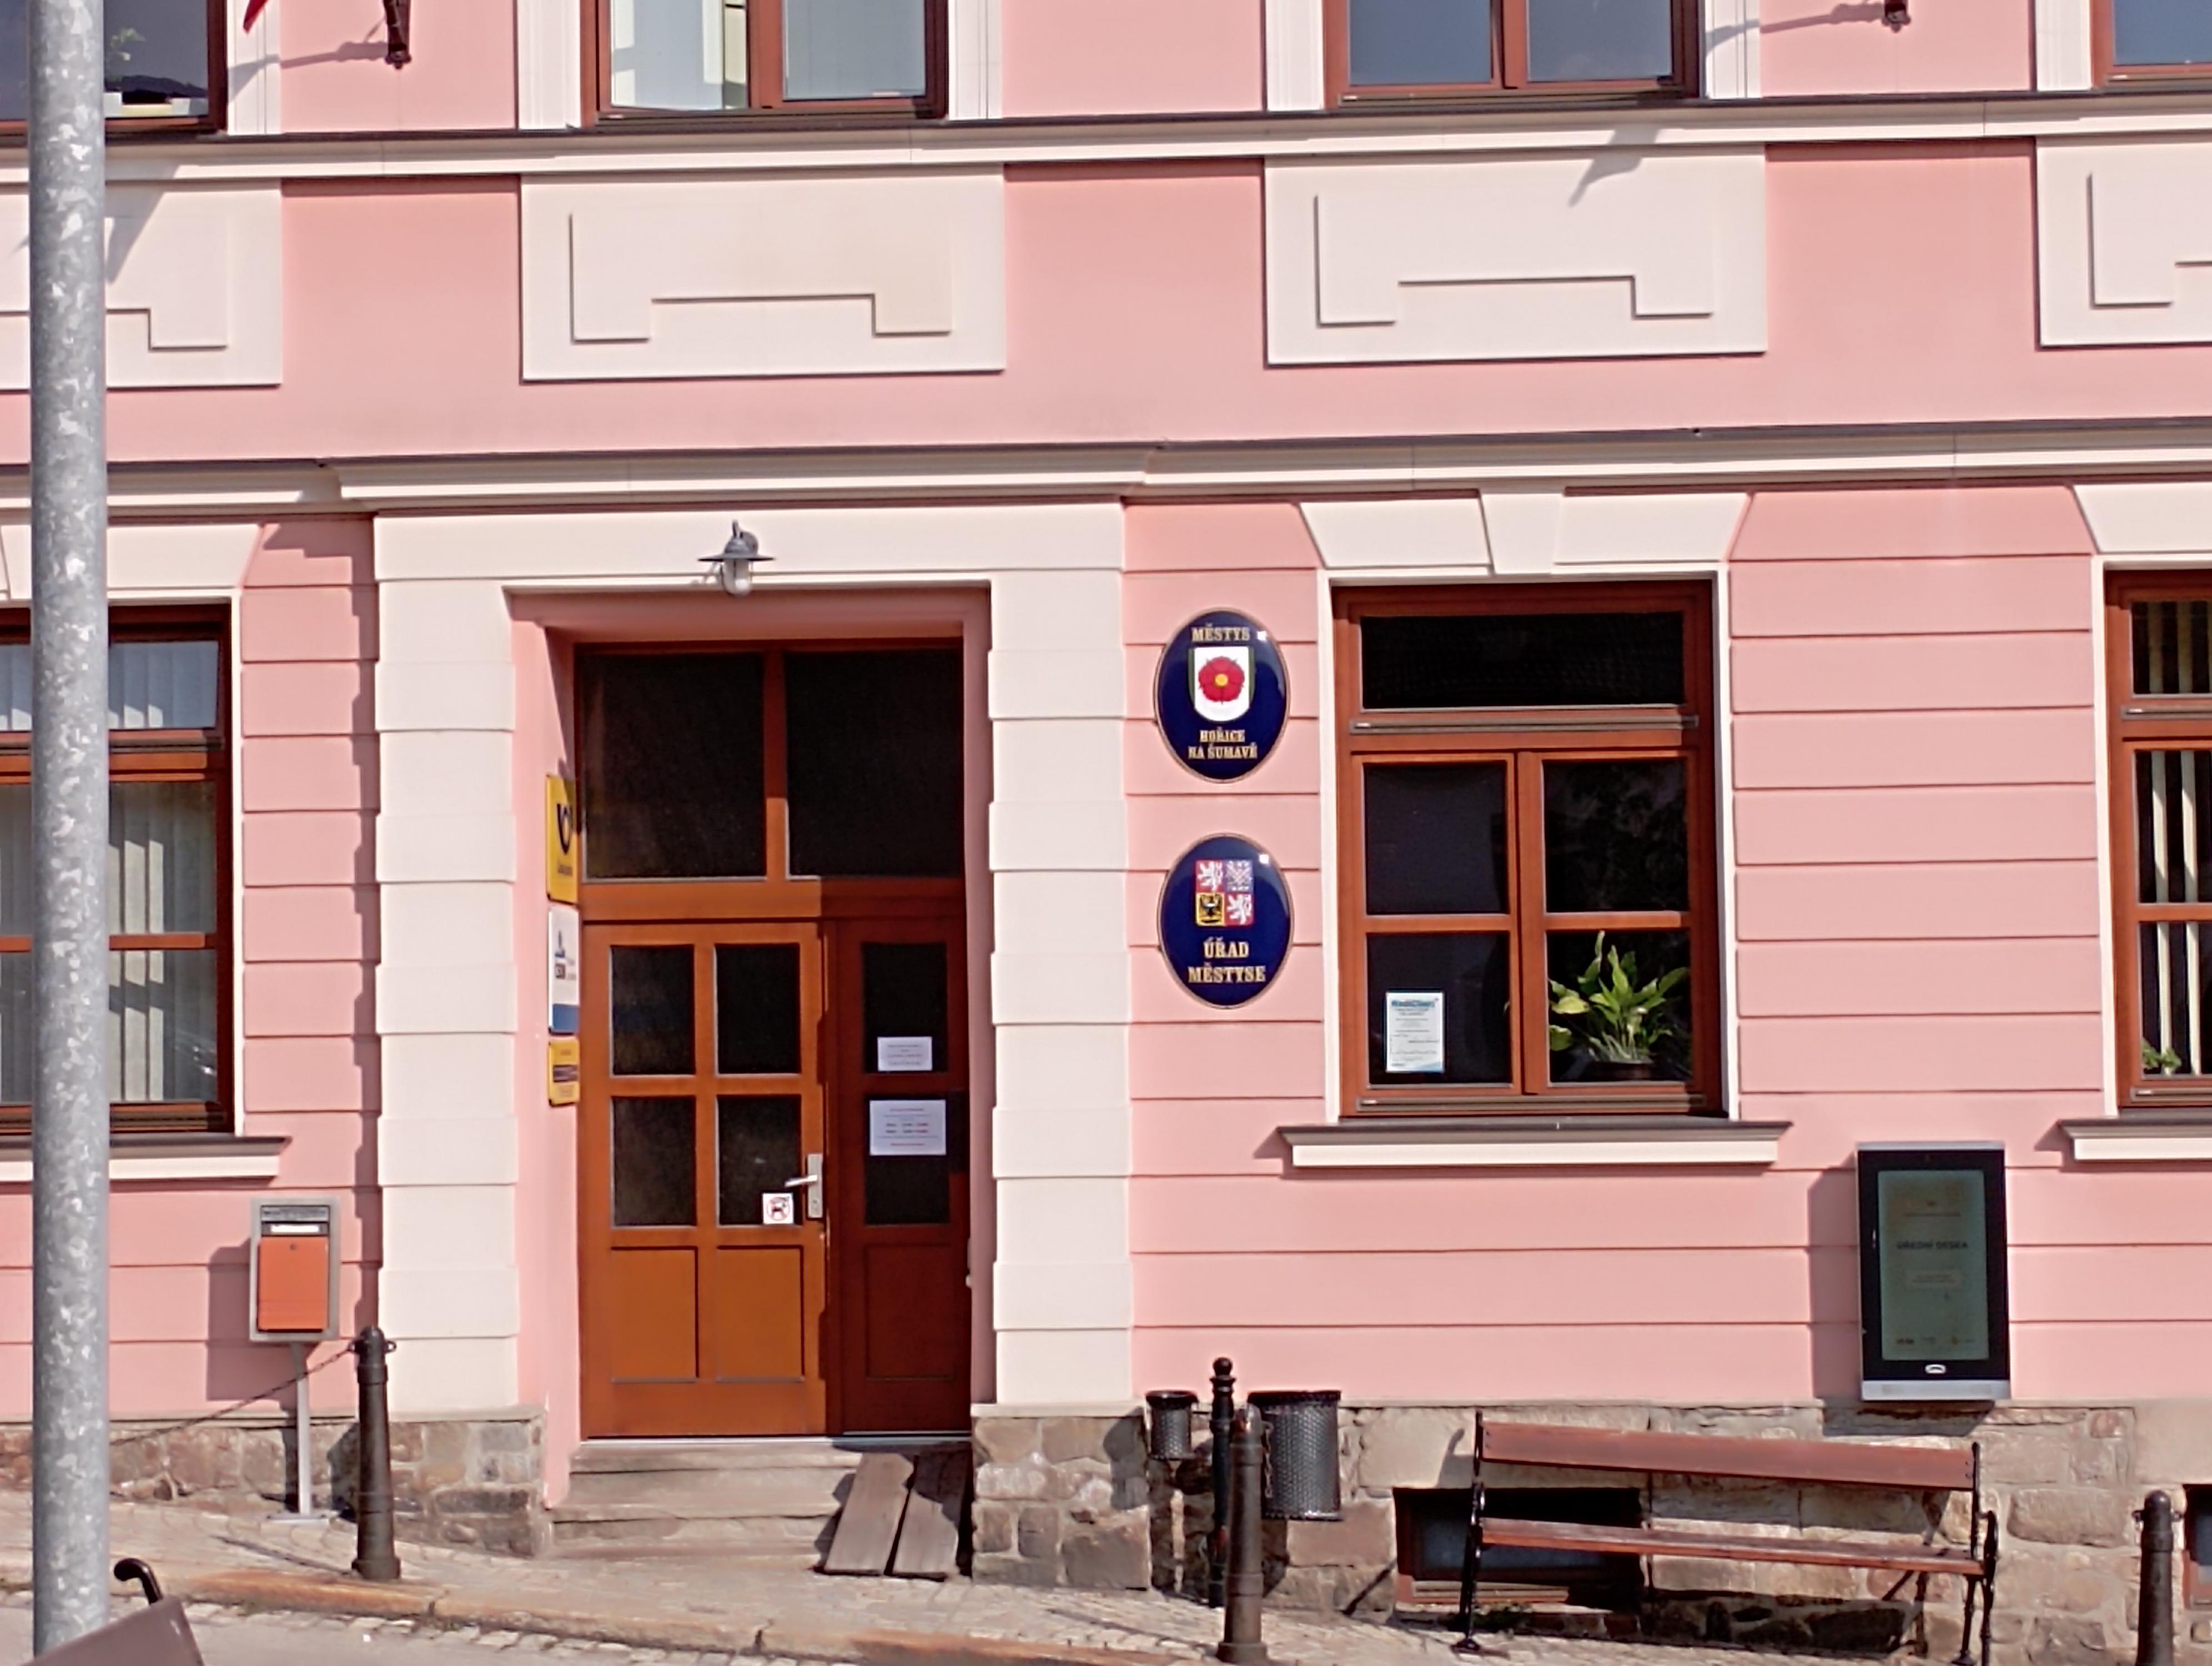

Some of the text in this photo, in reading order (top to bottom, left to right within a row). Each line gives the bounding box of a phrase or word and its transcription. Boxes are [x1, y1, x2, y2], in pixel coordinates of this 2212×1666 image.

[1192, 623, 1250, 641] MĚSTYS
[1200, 726, 1245, 742] HOŘICE
[1188, 742, 1258, 759] NA ŠUMAVĚ
[1204, 937, 1249, 959] ÚŘAD
[1188, 962, 1266, 983] MĚSTYSE
